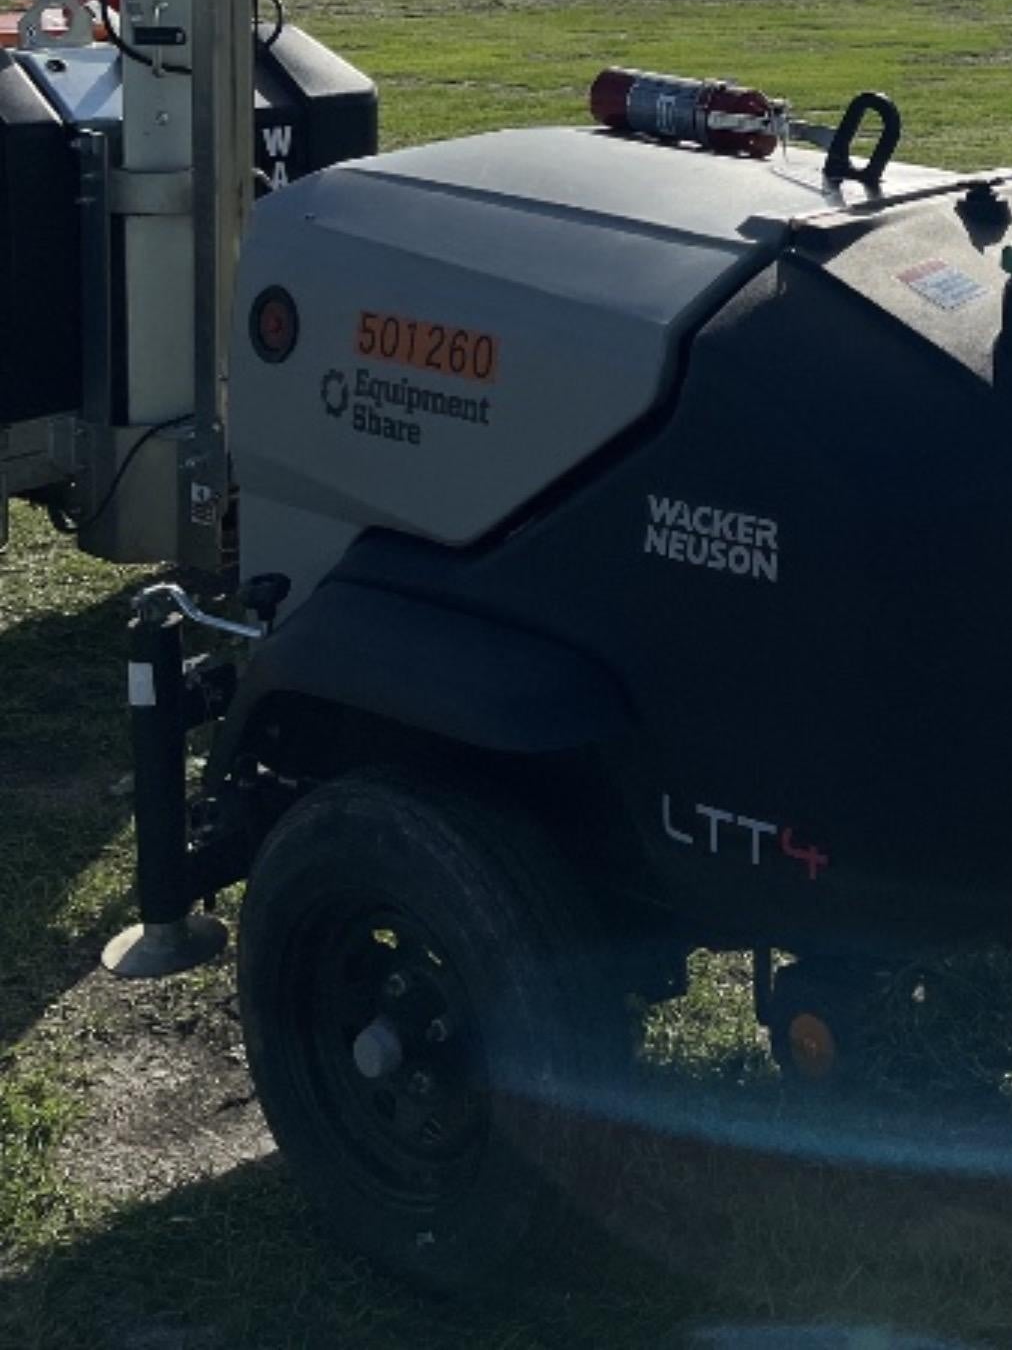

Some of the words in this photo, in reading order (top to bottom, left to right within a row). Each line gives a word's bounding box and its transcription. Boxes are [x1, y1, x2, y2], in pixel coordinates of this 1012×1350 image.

[359, 313, 492, 379] 501260
[352, 404, 421, 445] Share
[354, 369, 490, 425] Equipment
[648, 494, 778, 549] WACKER
[644, 524, 778, 582] NEUSON
[662, 794, 829, 880] LTT4
